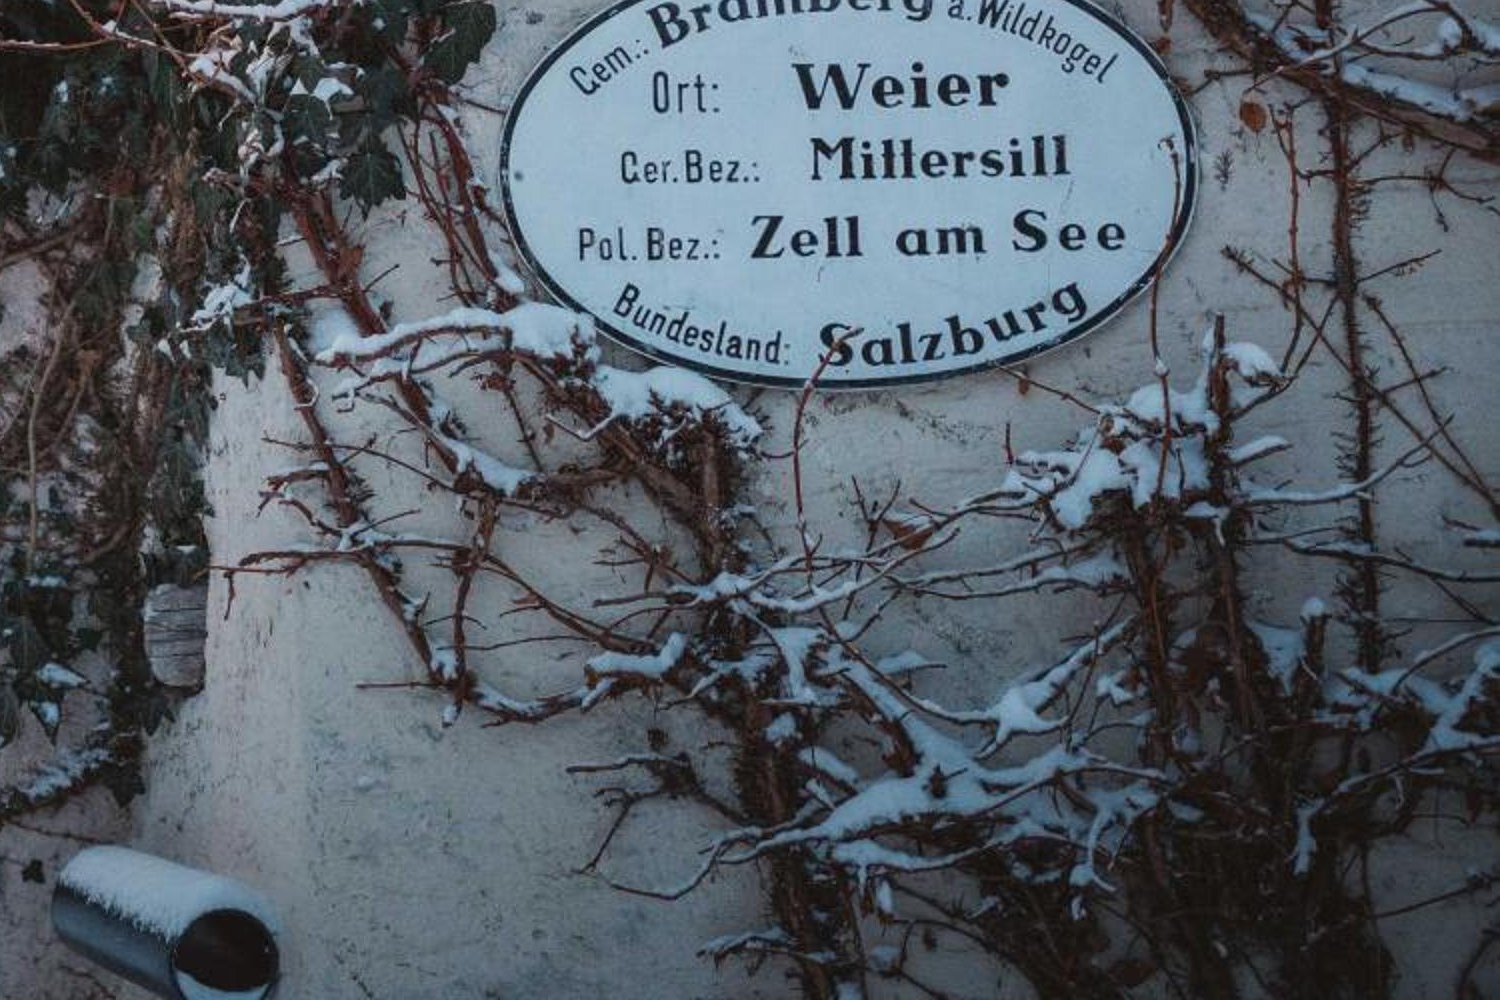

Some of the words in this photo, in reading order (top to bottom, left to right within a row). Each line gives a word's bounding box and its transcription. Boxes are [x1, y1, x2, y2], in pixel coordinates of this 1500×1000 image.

[652, 70, 720, 114] Ort:
[790, 61, 1011, 111] Weier
[810, 134, 1072, 181] Mittersill
[750, 215, 864, 259] Zell
[895, 223, 988, 257] am
[1011, 208, 1127, 253] See
[612, 281, 791, 366] Bundesland:
[818, 281, 1088, 368] Salzburg
